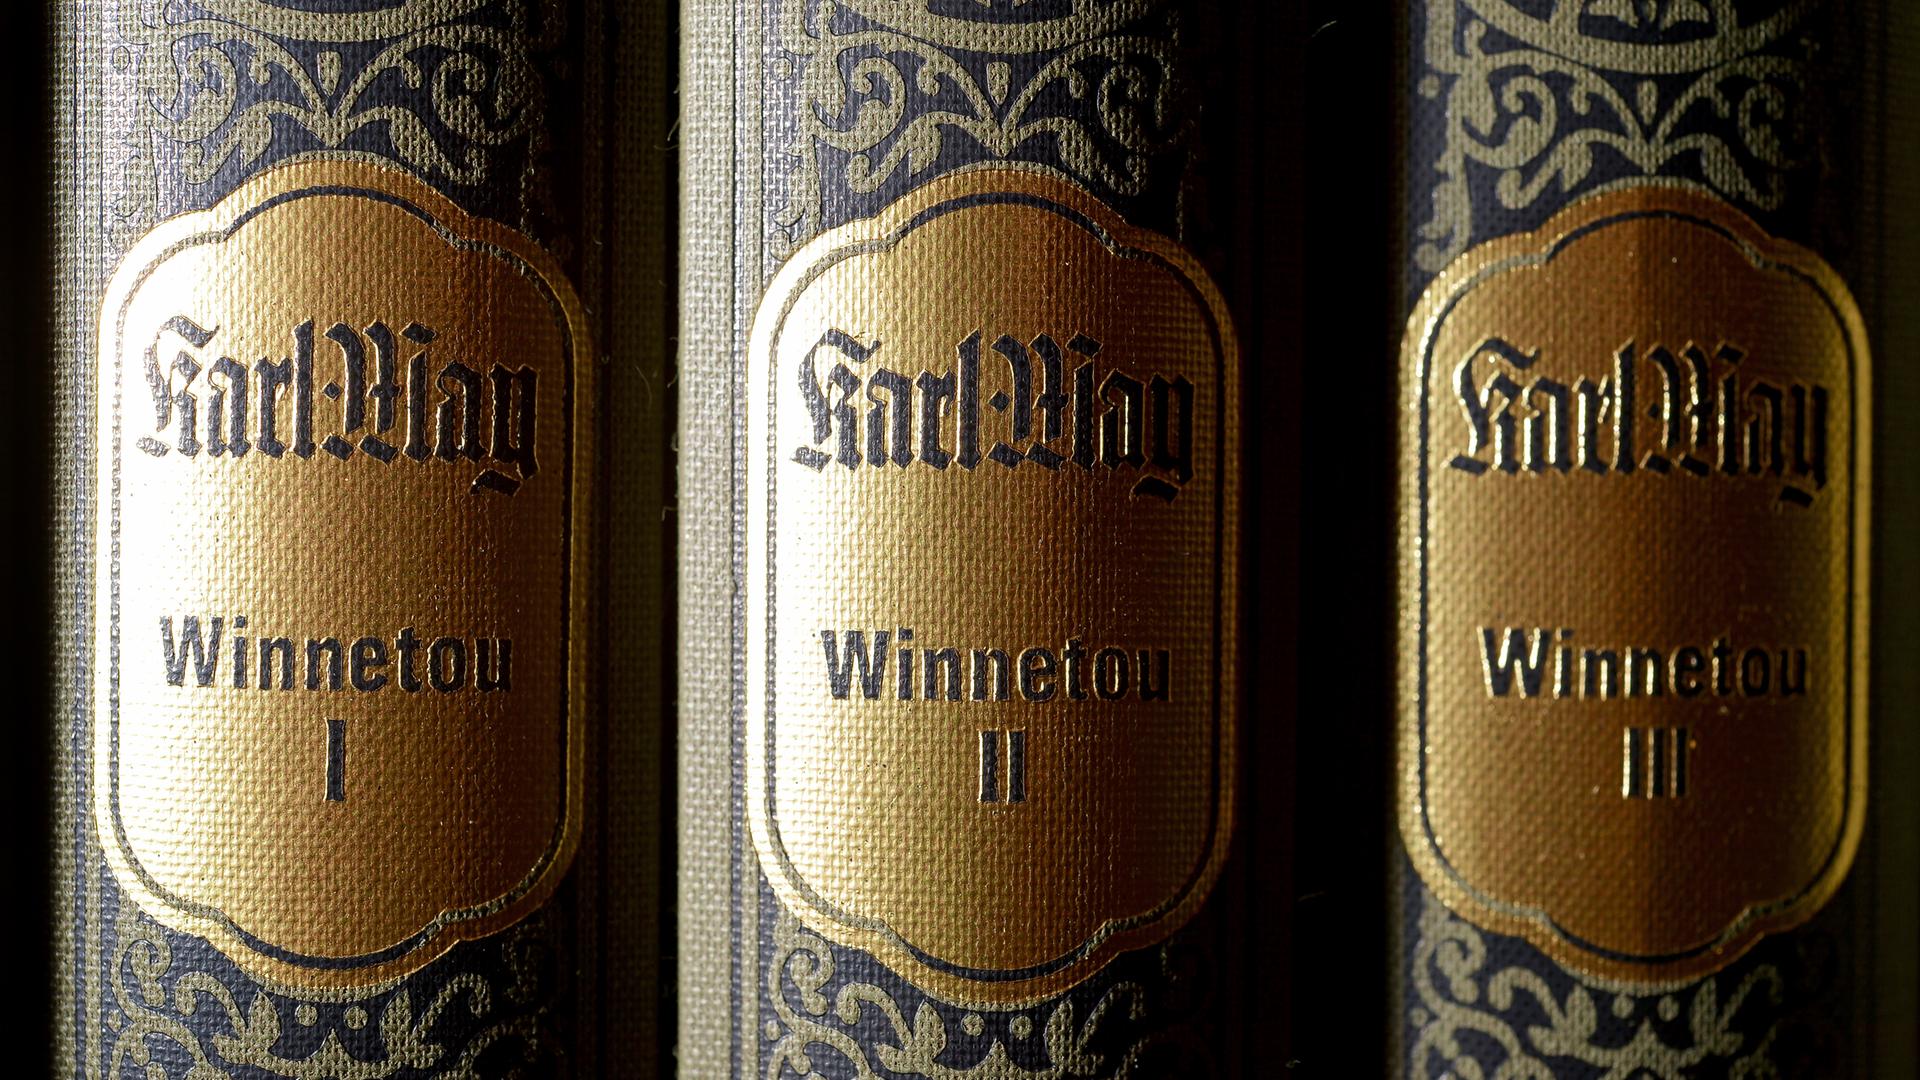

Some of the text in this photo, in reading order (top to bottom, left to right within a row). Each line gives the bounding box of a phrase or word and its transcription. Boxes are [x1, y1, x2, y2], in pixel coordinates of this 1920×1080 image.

[137, 315, 540, 496] Karl May
[790, 328, 1195, 500] Karl May
[1441, 337, 1829, 508] Karl May
[160, 615, 512, 693] Winnetou
[821, 628, 1171, 702] Winnetou
[1477, 626, 1811, 700] Winnetou
[325, 719, 346, 801] I
[978, 728, 1027, 804] II
[1622, 726, 1690, 799] III
